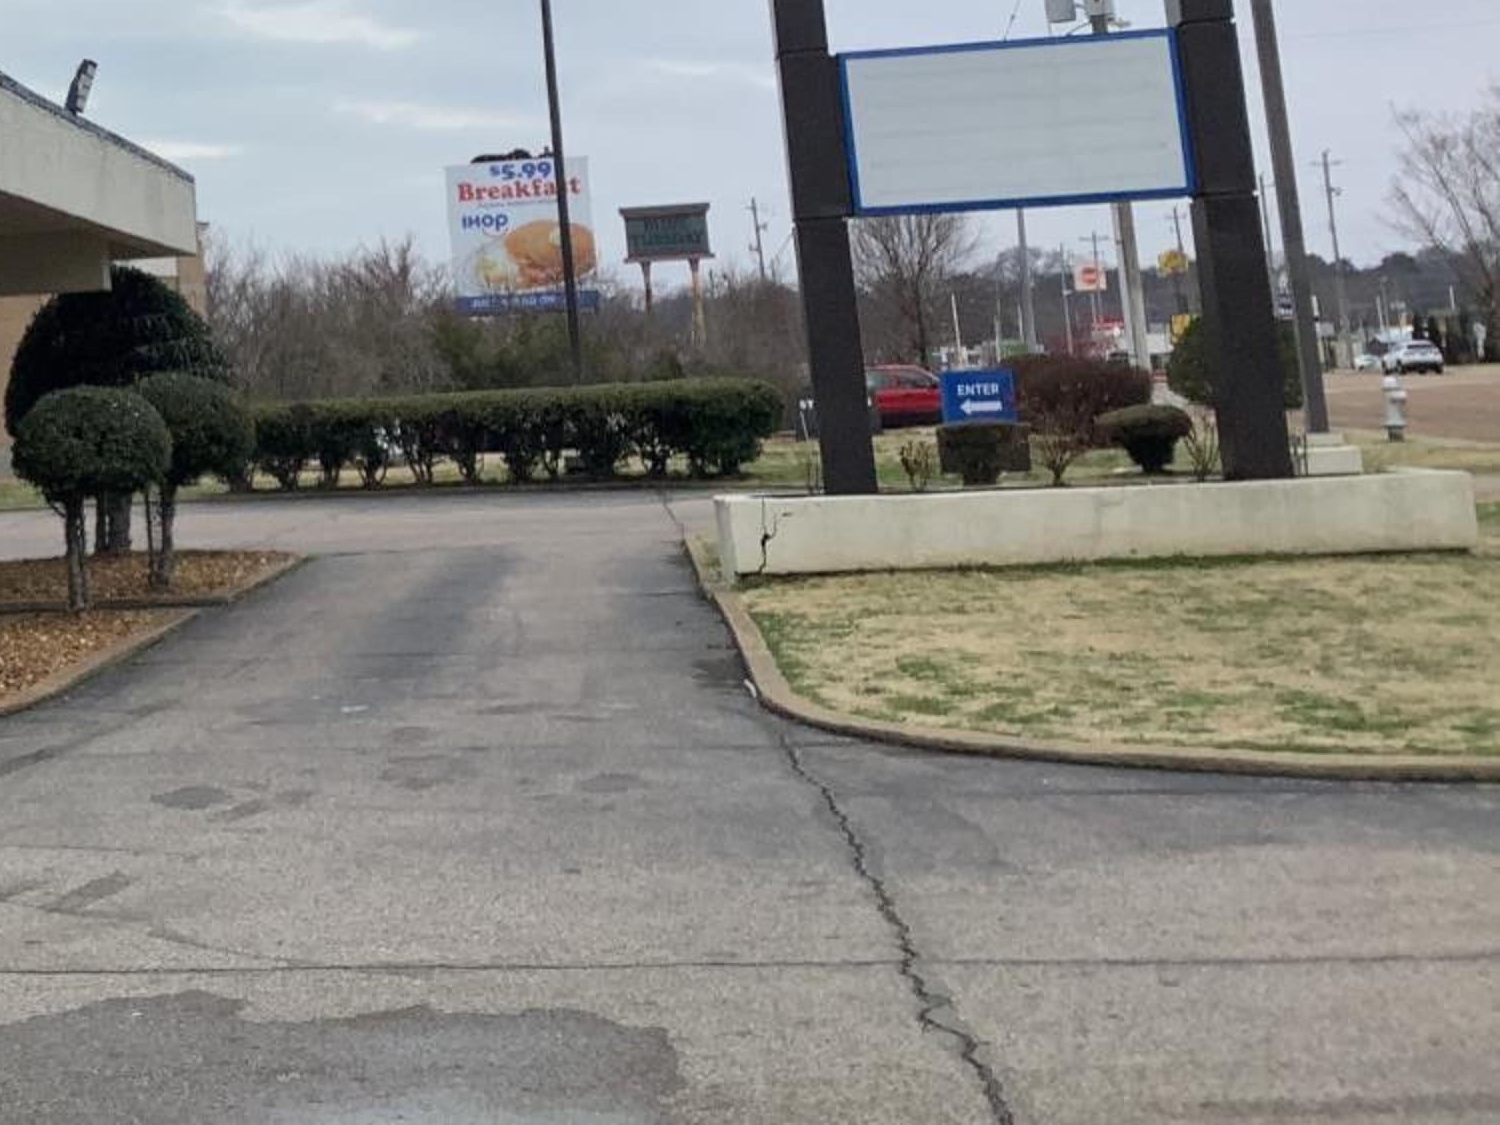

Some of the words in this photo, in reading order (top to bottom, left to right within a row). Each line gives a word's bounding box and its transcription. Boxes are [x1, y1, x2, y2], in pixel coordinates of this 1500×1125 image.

[489, 161, 551, 180] $5.99
[457, 177, 581, 203] Breakfat
[957, 382, 999, 396] ENTER
